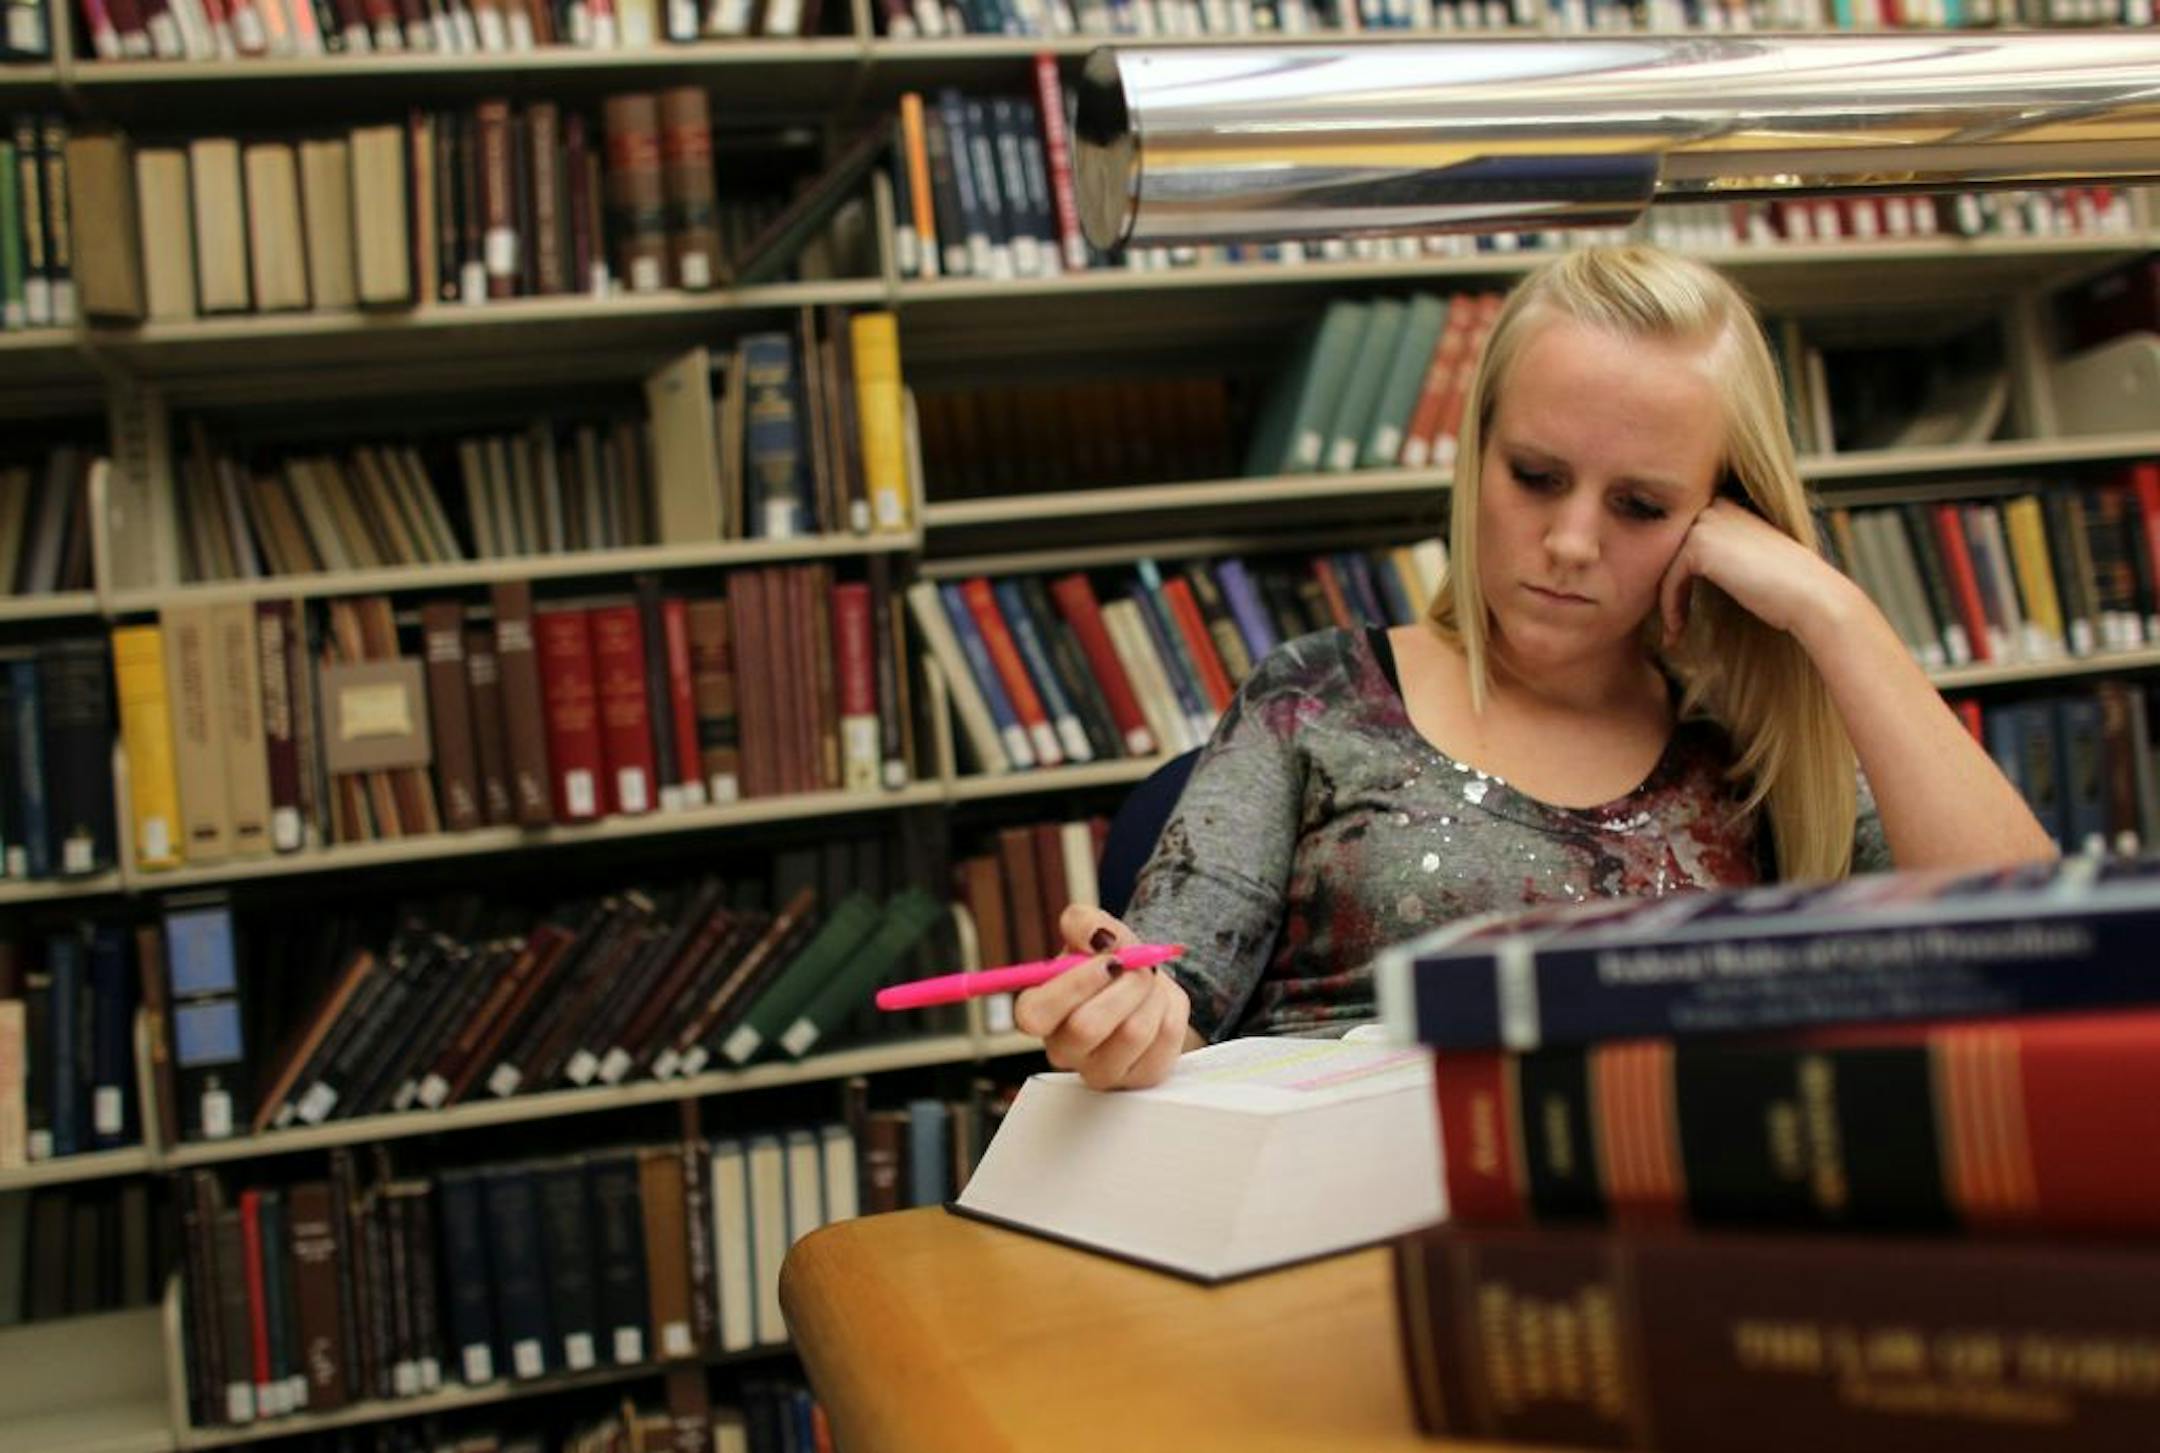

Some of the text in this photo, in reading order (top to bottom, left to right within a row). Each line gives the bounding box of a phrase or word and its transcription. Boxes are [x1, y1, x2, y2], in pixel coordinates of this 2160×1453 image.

[1598, 949, 1702, 985] Federal
[1711, 943, 1790, 978] Rules
[1805, 939, 1836, 969] of
[1920, 922, 2094, 960] Procedure
[1736, 1321, 1821, 1368] THE
[1937, 1331, 2002, 1380] OF
